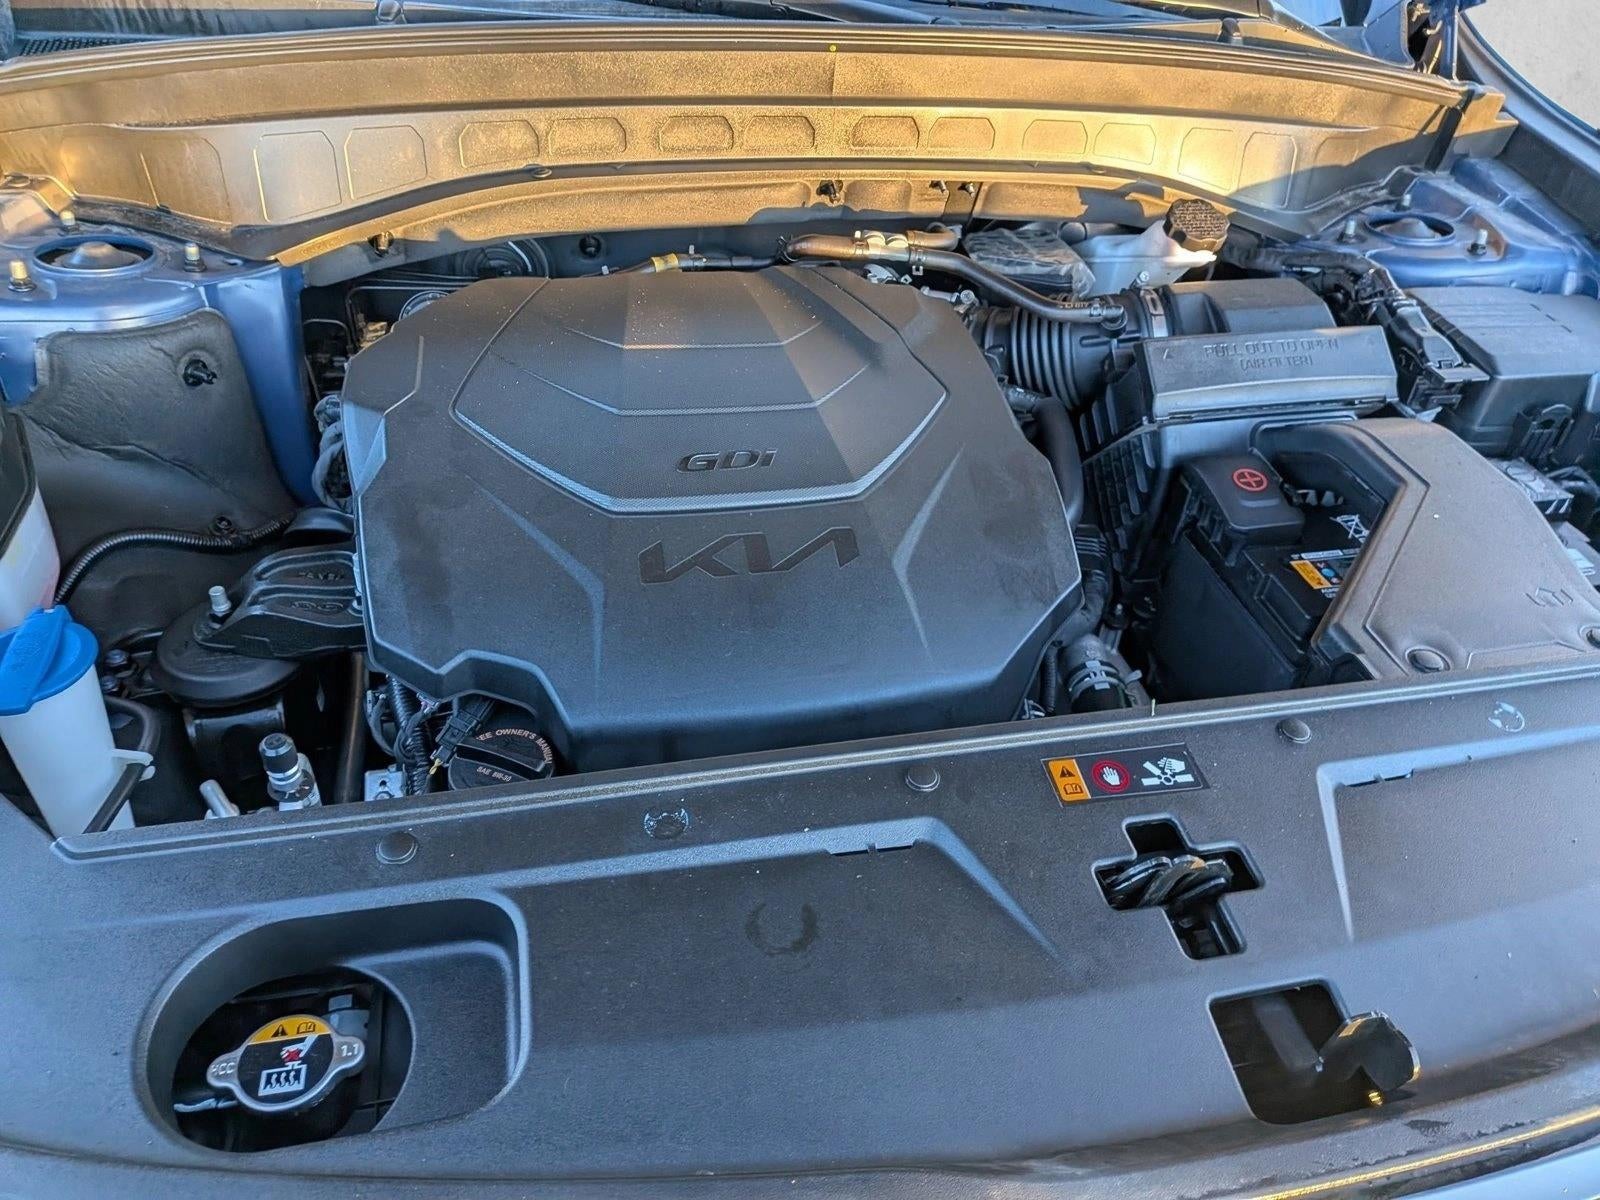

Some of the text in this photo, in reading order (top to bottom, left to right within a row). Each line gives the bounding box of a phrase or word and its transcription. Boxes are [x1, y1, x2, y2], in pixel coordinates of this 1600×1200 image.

[1203, 337, 1339, 357] PULL OUT TO OPEN
[638, 526, 860, 585] KIA
[495, 728, 536, 739] OWNER'S
